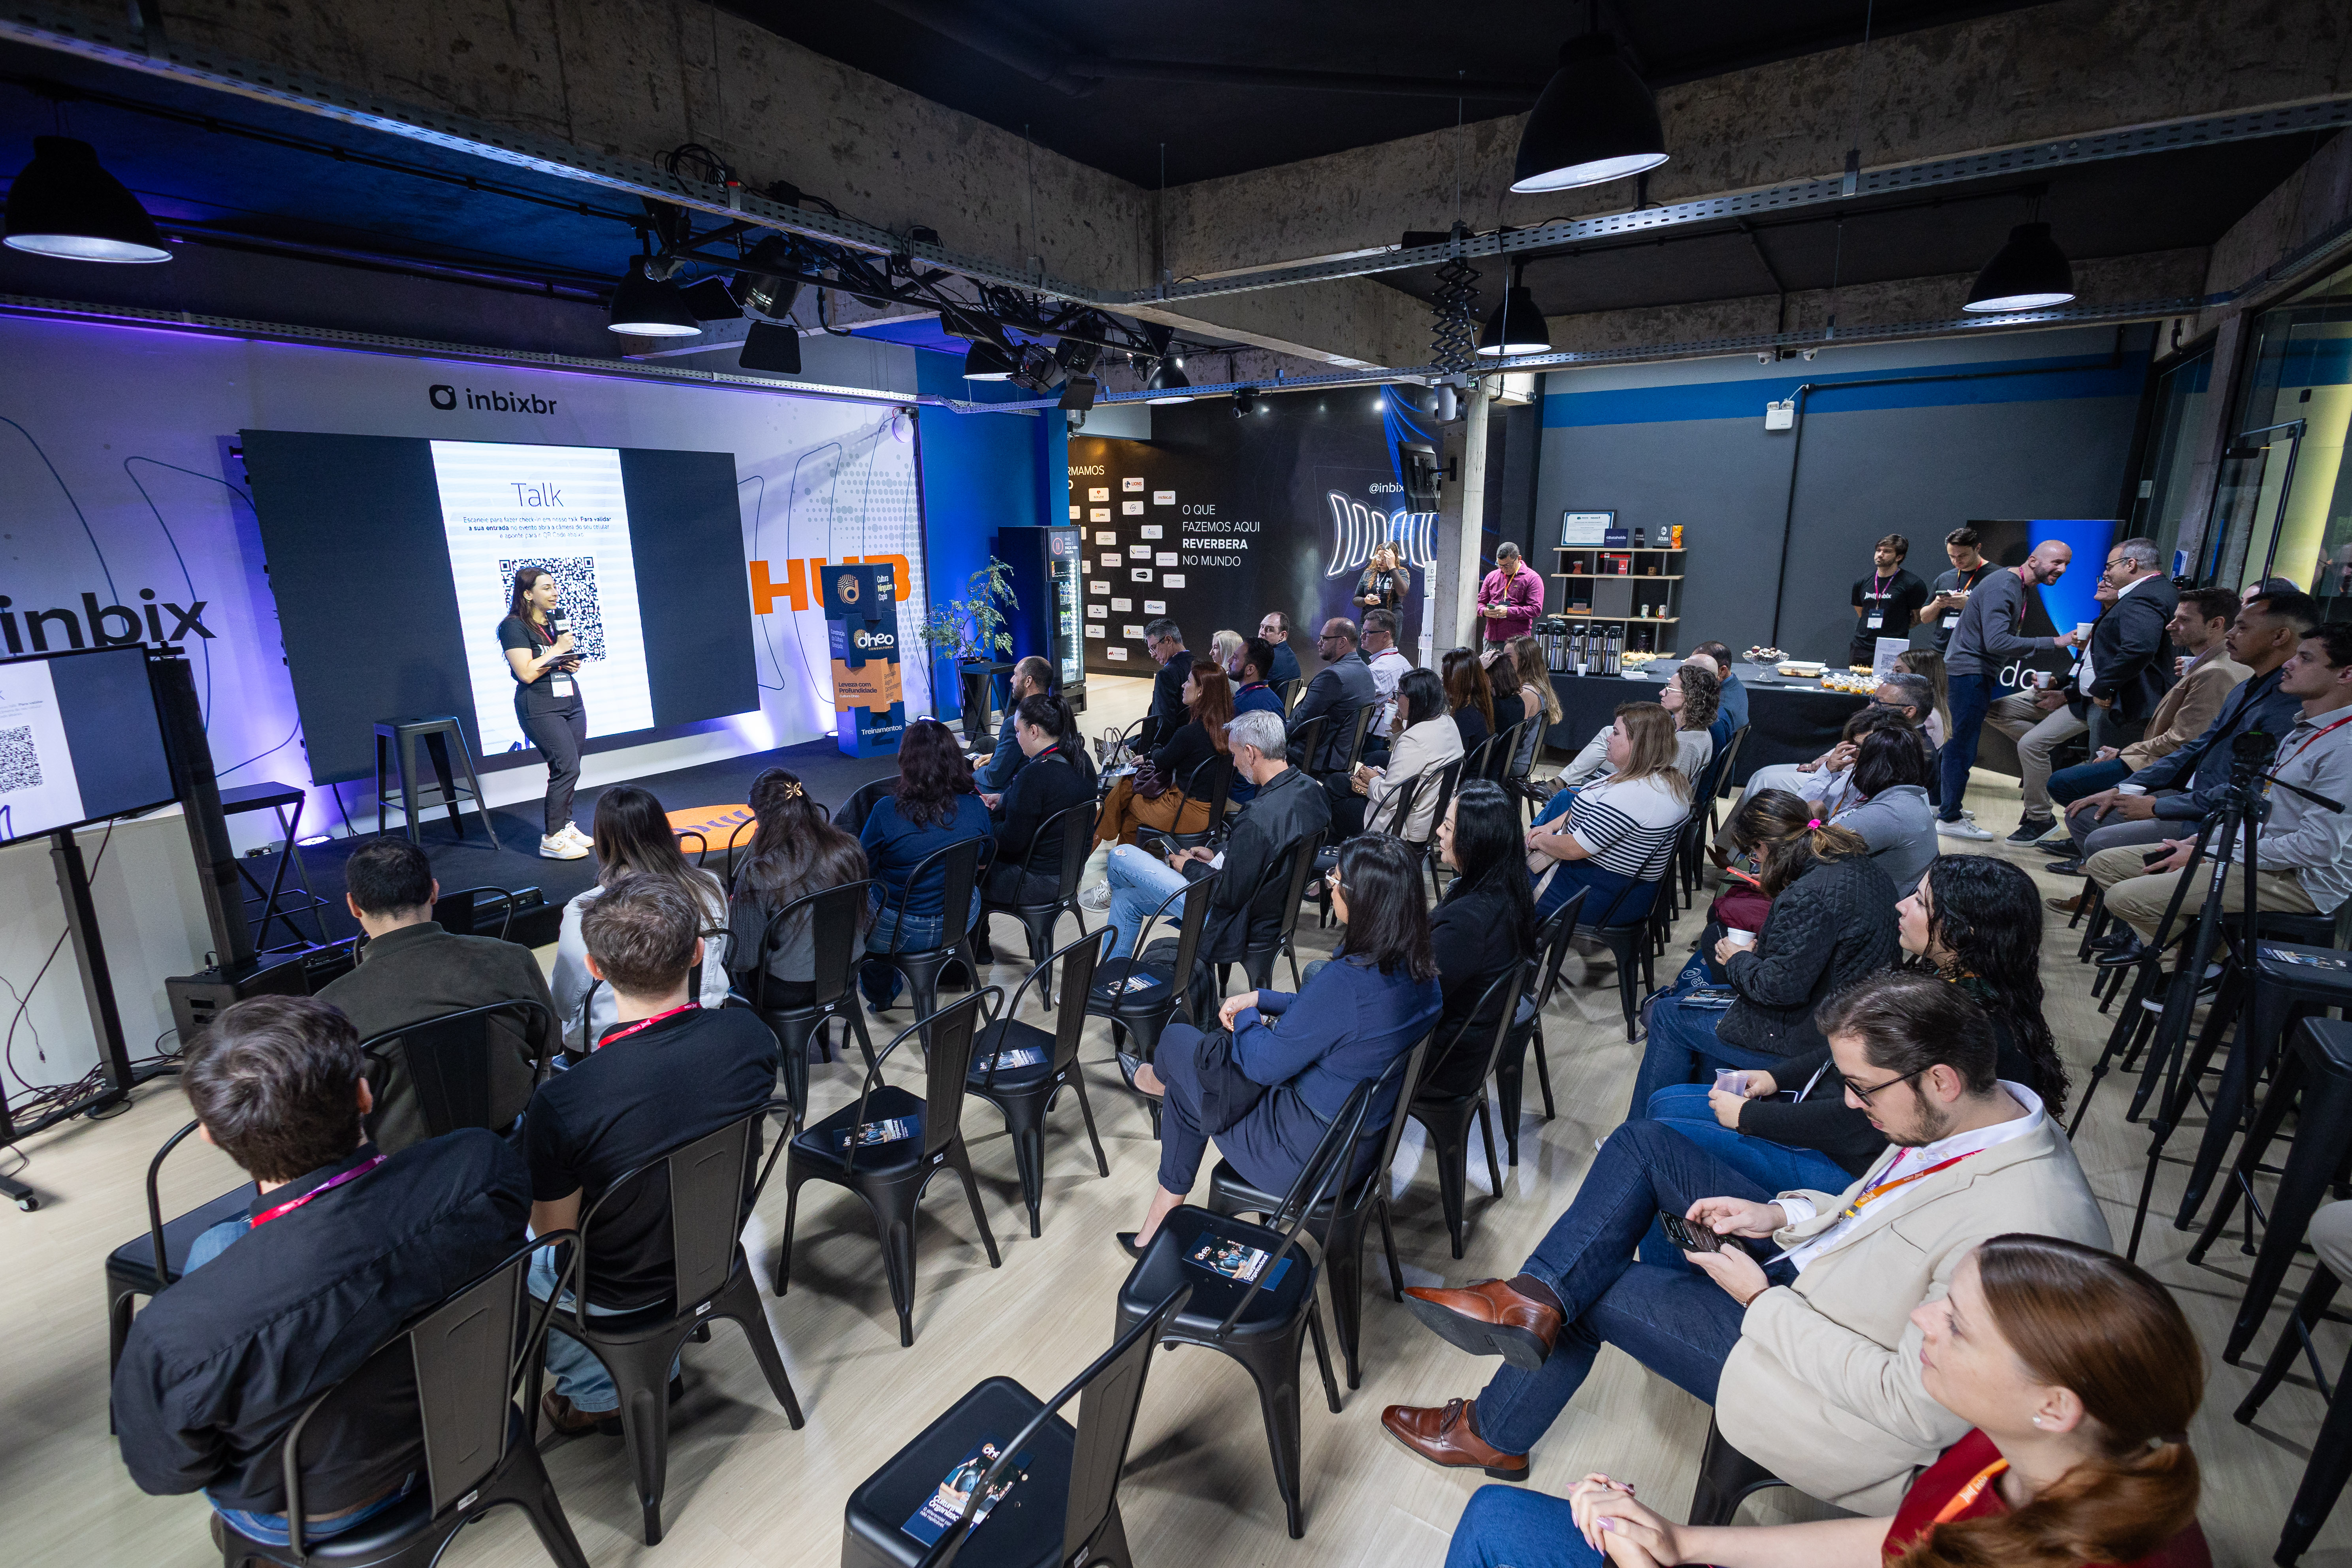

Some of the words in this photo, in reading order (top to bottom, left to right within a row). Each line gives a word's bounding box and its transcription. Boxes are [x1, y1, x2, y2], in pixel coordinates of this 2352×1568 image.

[466, 388, 557, 415] inbixbr
[511, 483, 564, 507] Talk
[1183, 504, 1190, 515] O
[1194, 504, 1216, 515] QUE
[1183, 521, 1231, 532] FAZEMOS
[1233, 521, 1260, 532] AQUI
[1183, 538, 1248, 549] REVERBERA
[1183, 555, 1198, 565] NO
[1201, 555, 1241, 566] MUNDO
[878, 583, 893, 592] Ninguém
[878, 593, 888, 602] Copia
[0, 588, 217, 654] inbix
[857, 632, 894, 648] dheo
[861, 725, 902, 735] Treinamentos
[2215, 862, 2226, 879] Tomato
[1198, 1246, 1211, 1259] dheo
[1248, 1254, 1269, 1282] Organizacional
[933, 1495, 957, 1512] Cultura
[926, 1509, 945, 1523] diferencial
